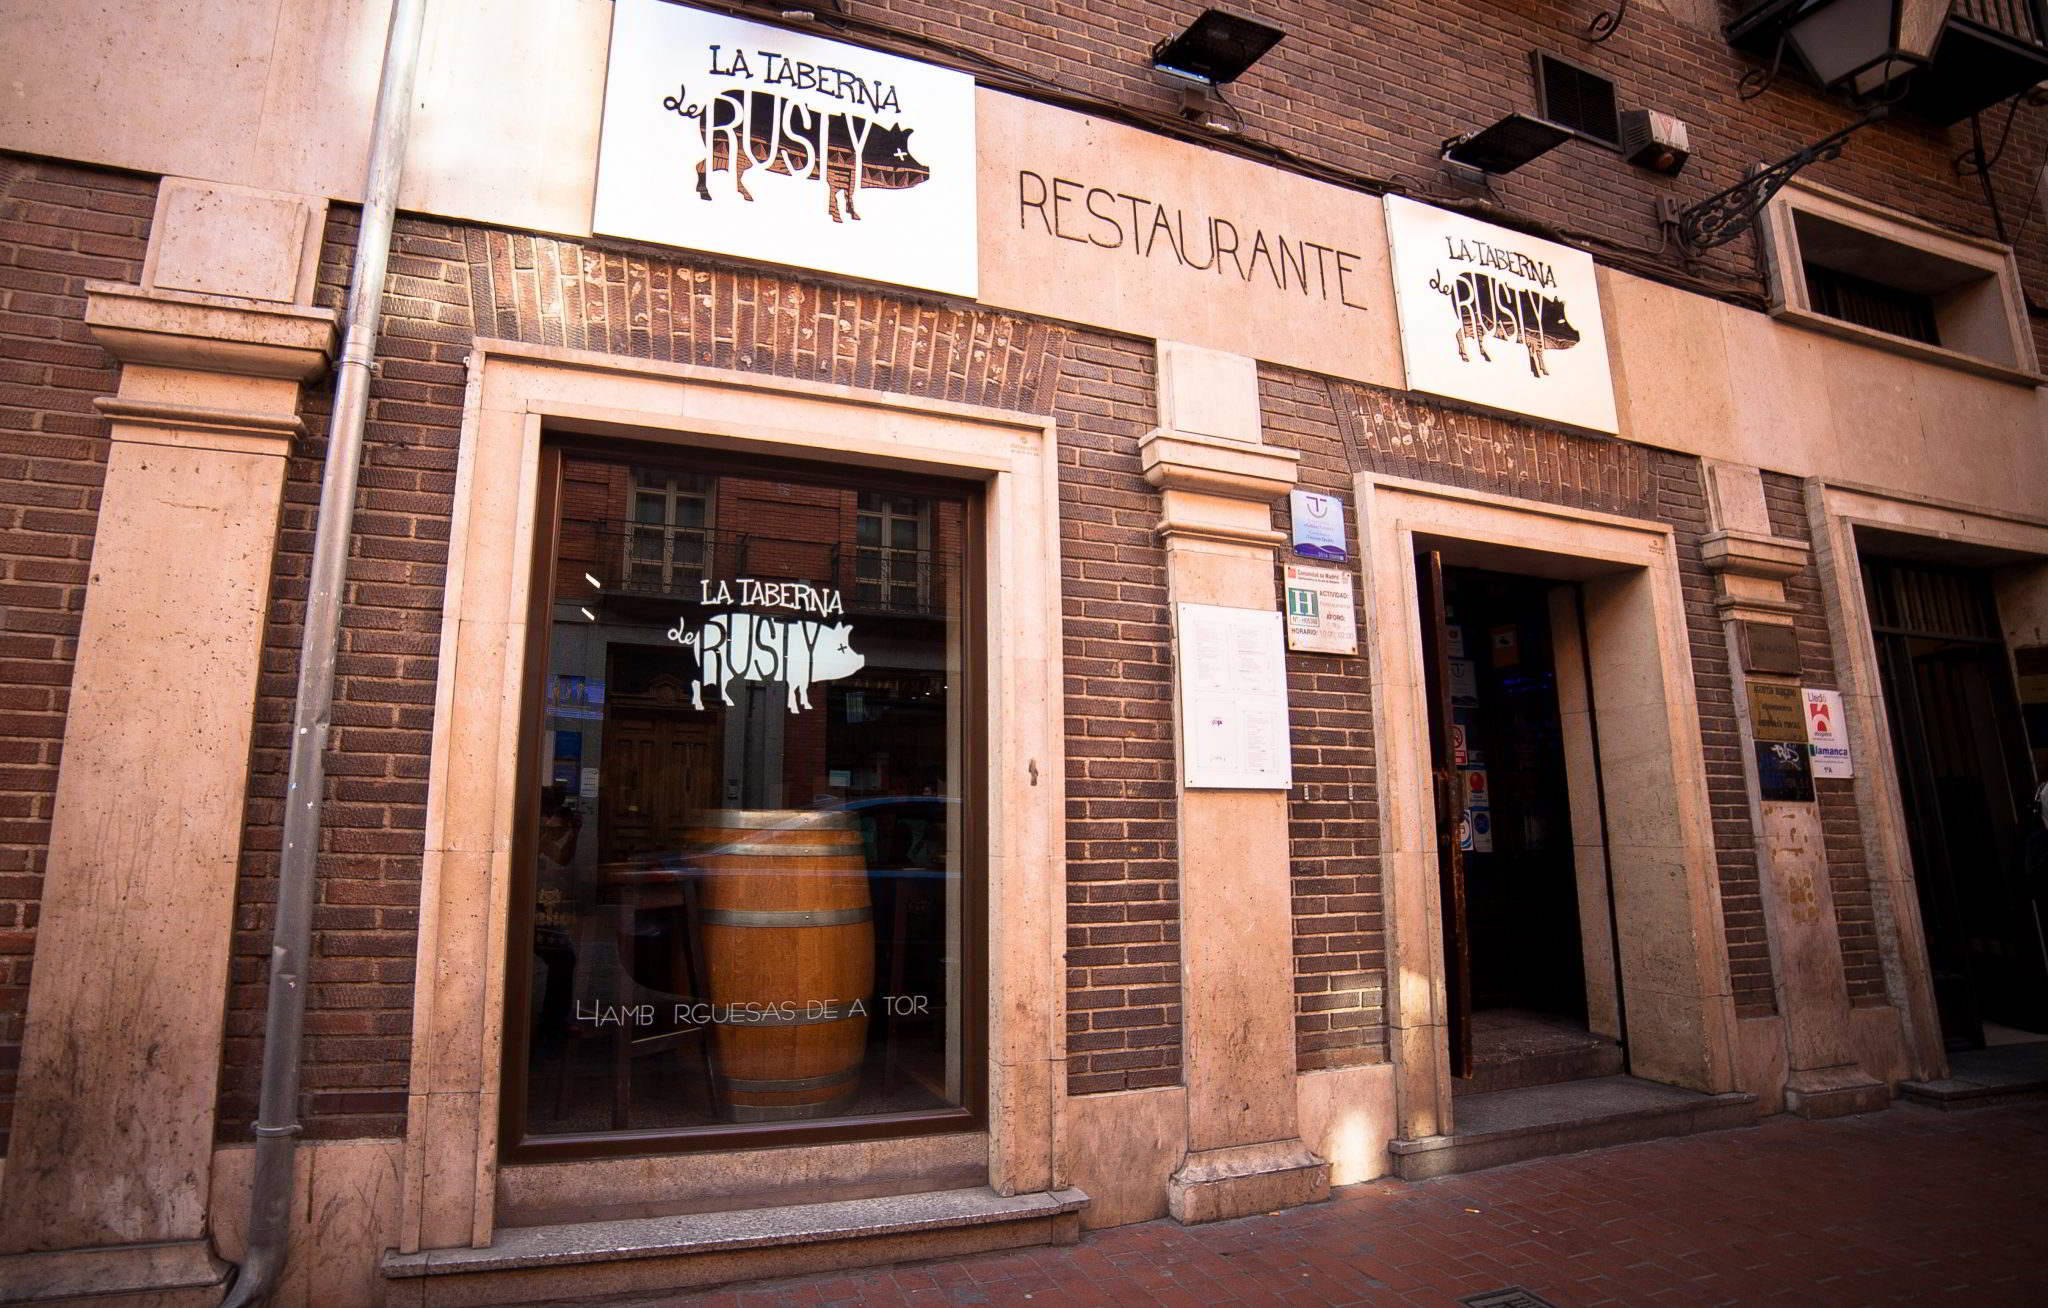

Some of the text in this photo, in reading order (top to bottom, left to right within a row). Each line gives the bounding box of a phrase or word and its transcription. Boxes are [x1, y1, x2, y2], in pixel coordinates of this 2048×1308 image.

[709, 45, 901, 114] LA TABERNA
[704, 88, 873, 190] RUSTY
[1019, 169, 1368, 311] RESTAURANTE
[1445, 236, 1557, 289] LA TABERNA
[1455, 272, 1545, 352] RUSTY
[700, 578, 844, 617] LA TABERNA
[699, 613, 820, 684] RUSTY
[806, 999, 839, 1020] DE
[883, 995, 929, 1017] TOR
